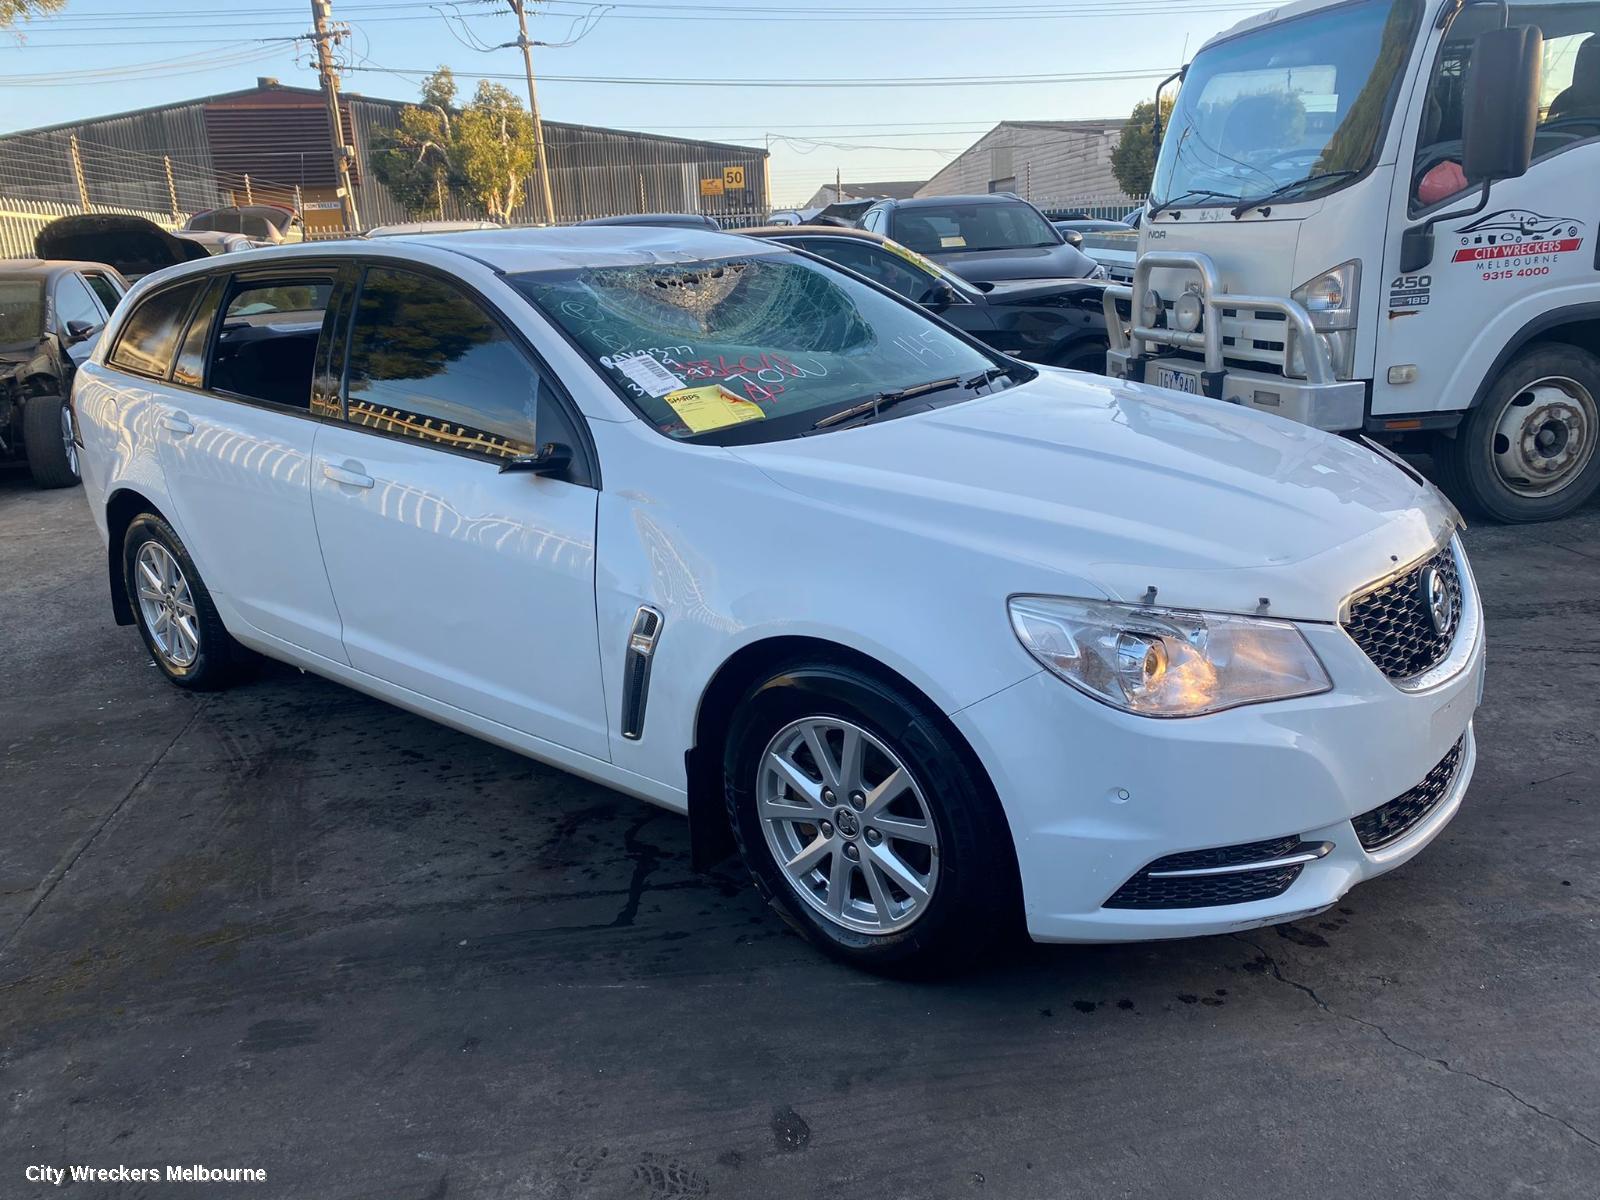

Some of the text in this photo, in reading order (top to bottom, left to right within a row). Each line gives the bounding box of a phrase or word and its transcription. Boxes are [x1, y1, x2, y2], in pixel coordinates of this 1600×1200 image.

[726, 171, 742, 184] 50
[1474, 240, 1561, 259] CITY WRECKERS
[1476, 254, 1558, 270] MELBOURNE
[1482, 266, 1550, 281] 9315 4000
[1391, 275, 1432, 289] 450
